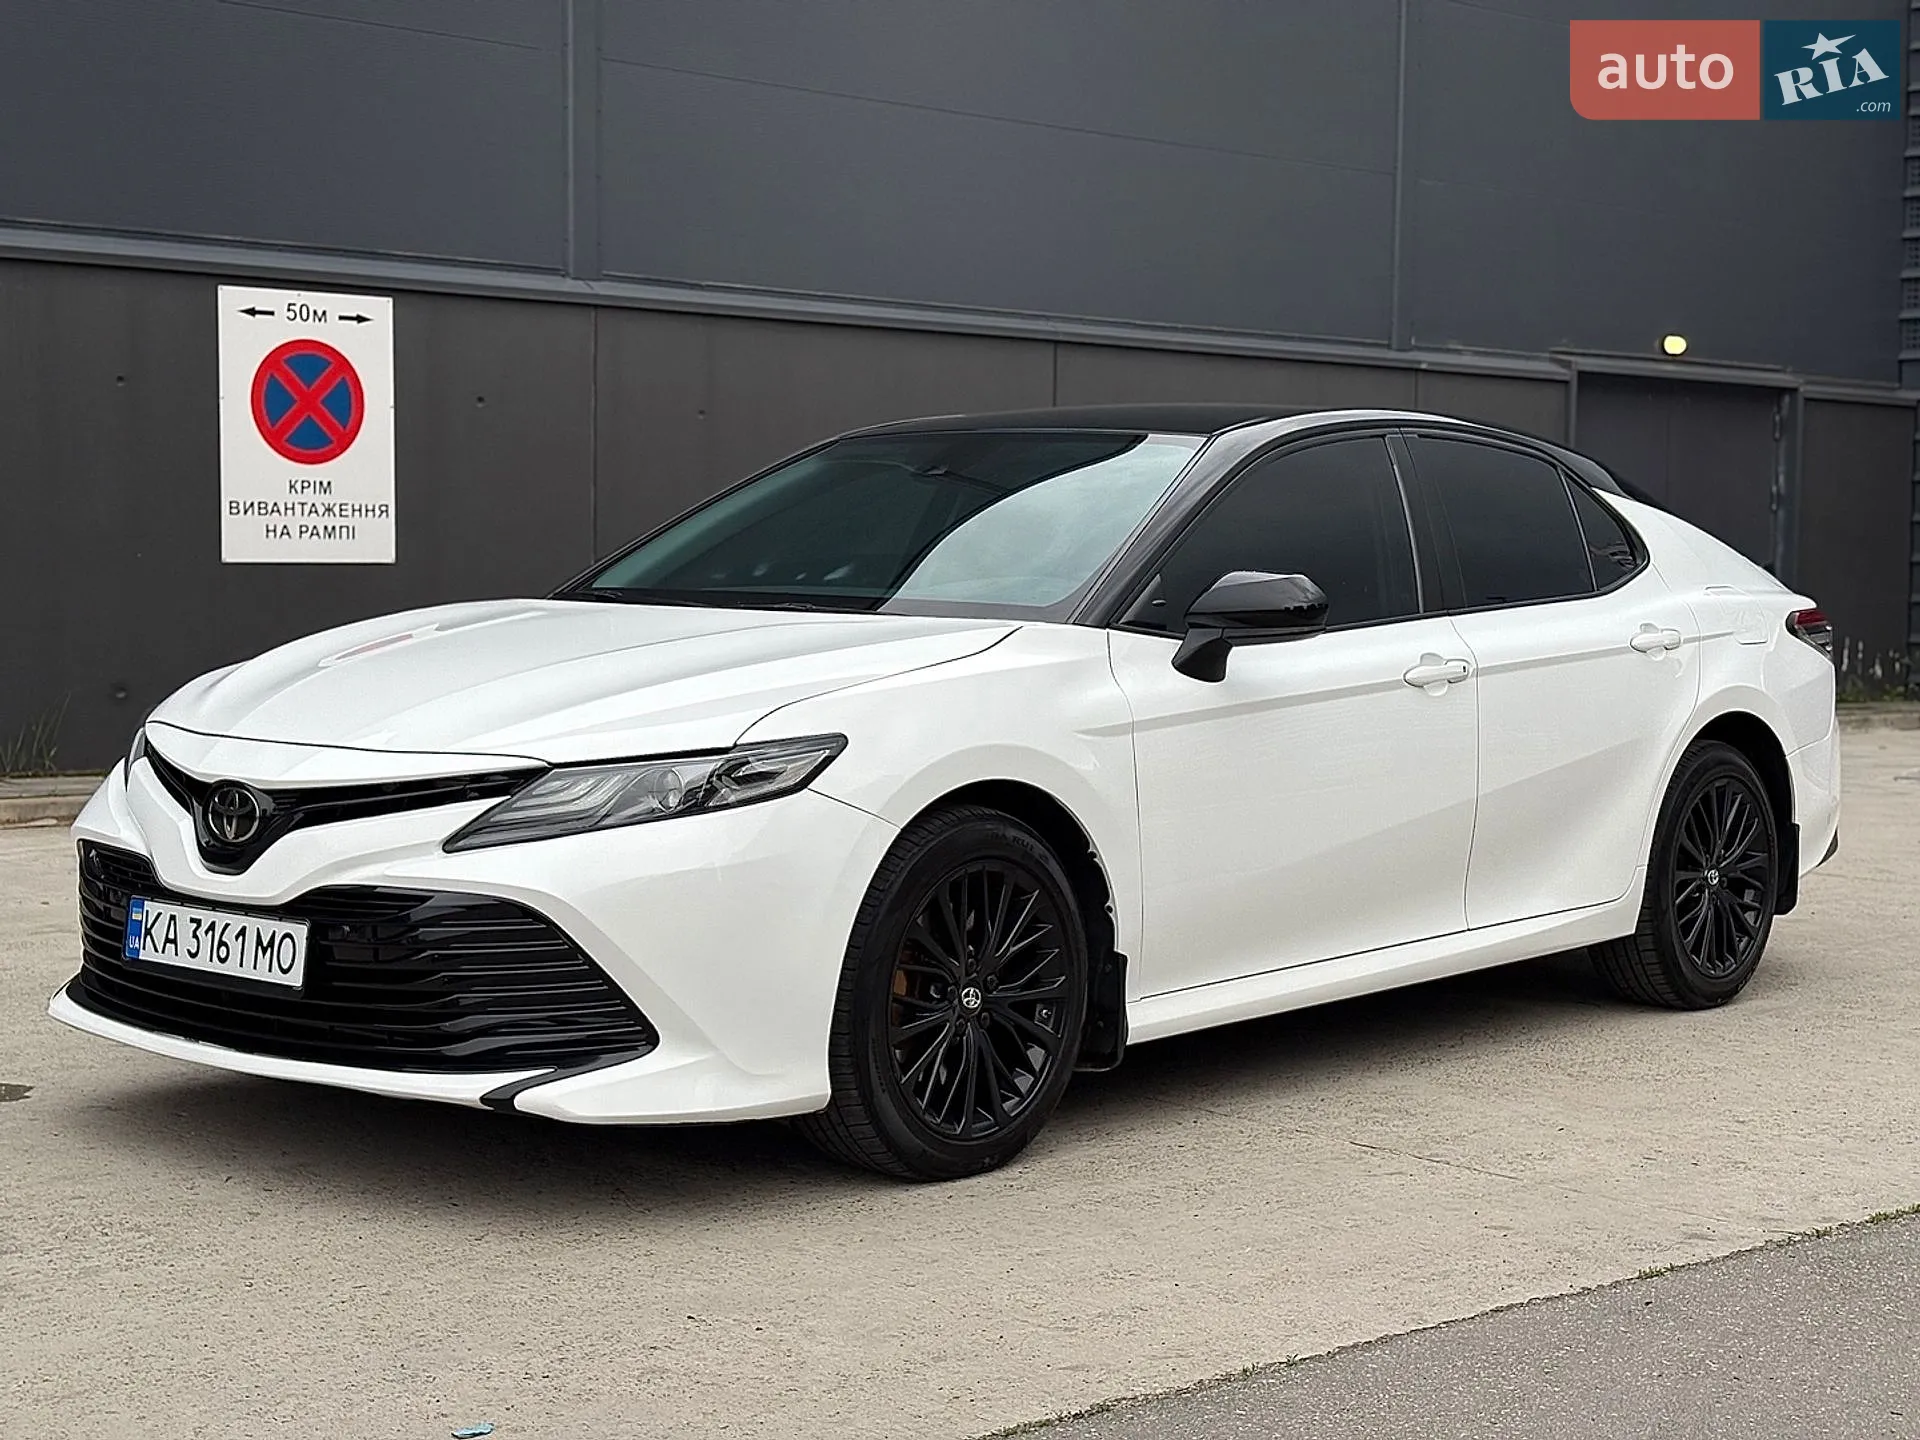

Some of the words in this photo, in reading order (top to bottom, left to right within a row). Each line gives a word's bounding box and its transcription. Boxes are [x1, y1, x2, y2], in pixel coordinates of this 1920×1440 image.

[288, 479, 333, 495] КРІМ
[228, 500, 390, 519] ВИВАНТАЖЕННЯ
[265, 524, 292, 539] НА
[298, 525, 356, 541] РАМПІ
[129, 935, 140, 949] UA
[142, 909, 179, 957] KA
[186, 916, 248, 968] 3161
[252, 926, 297, 975] MO
